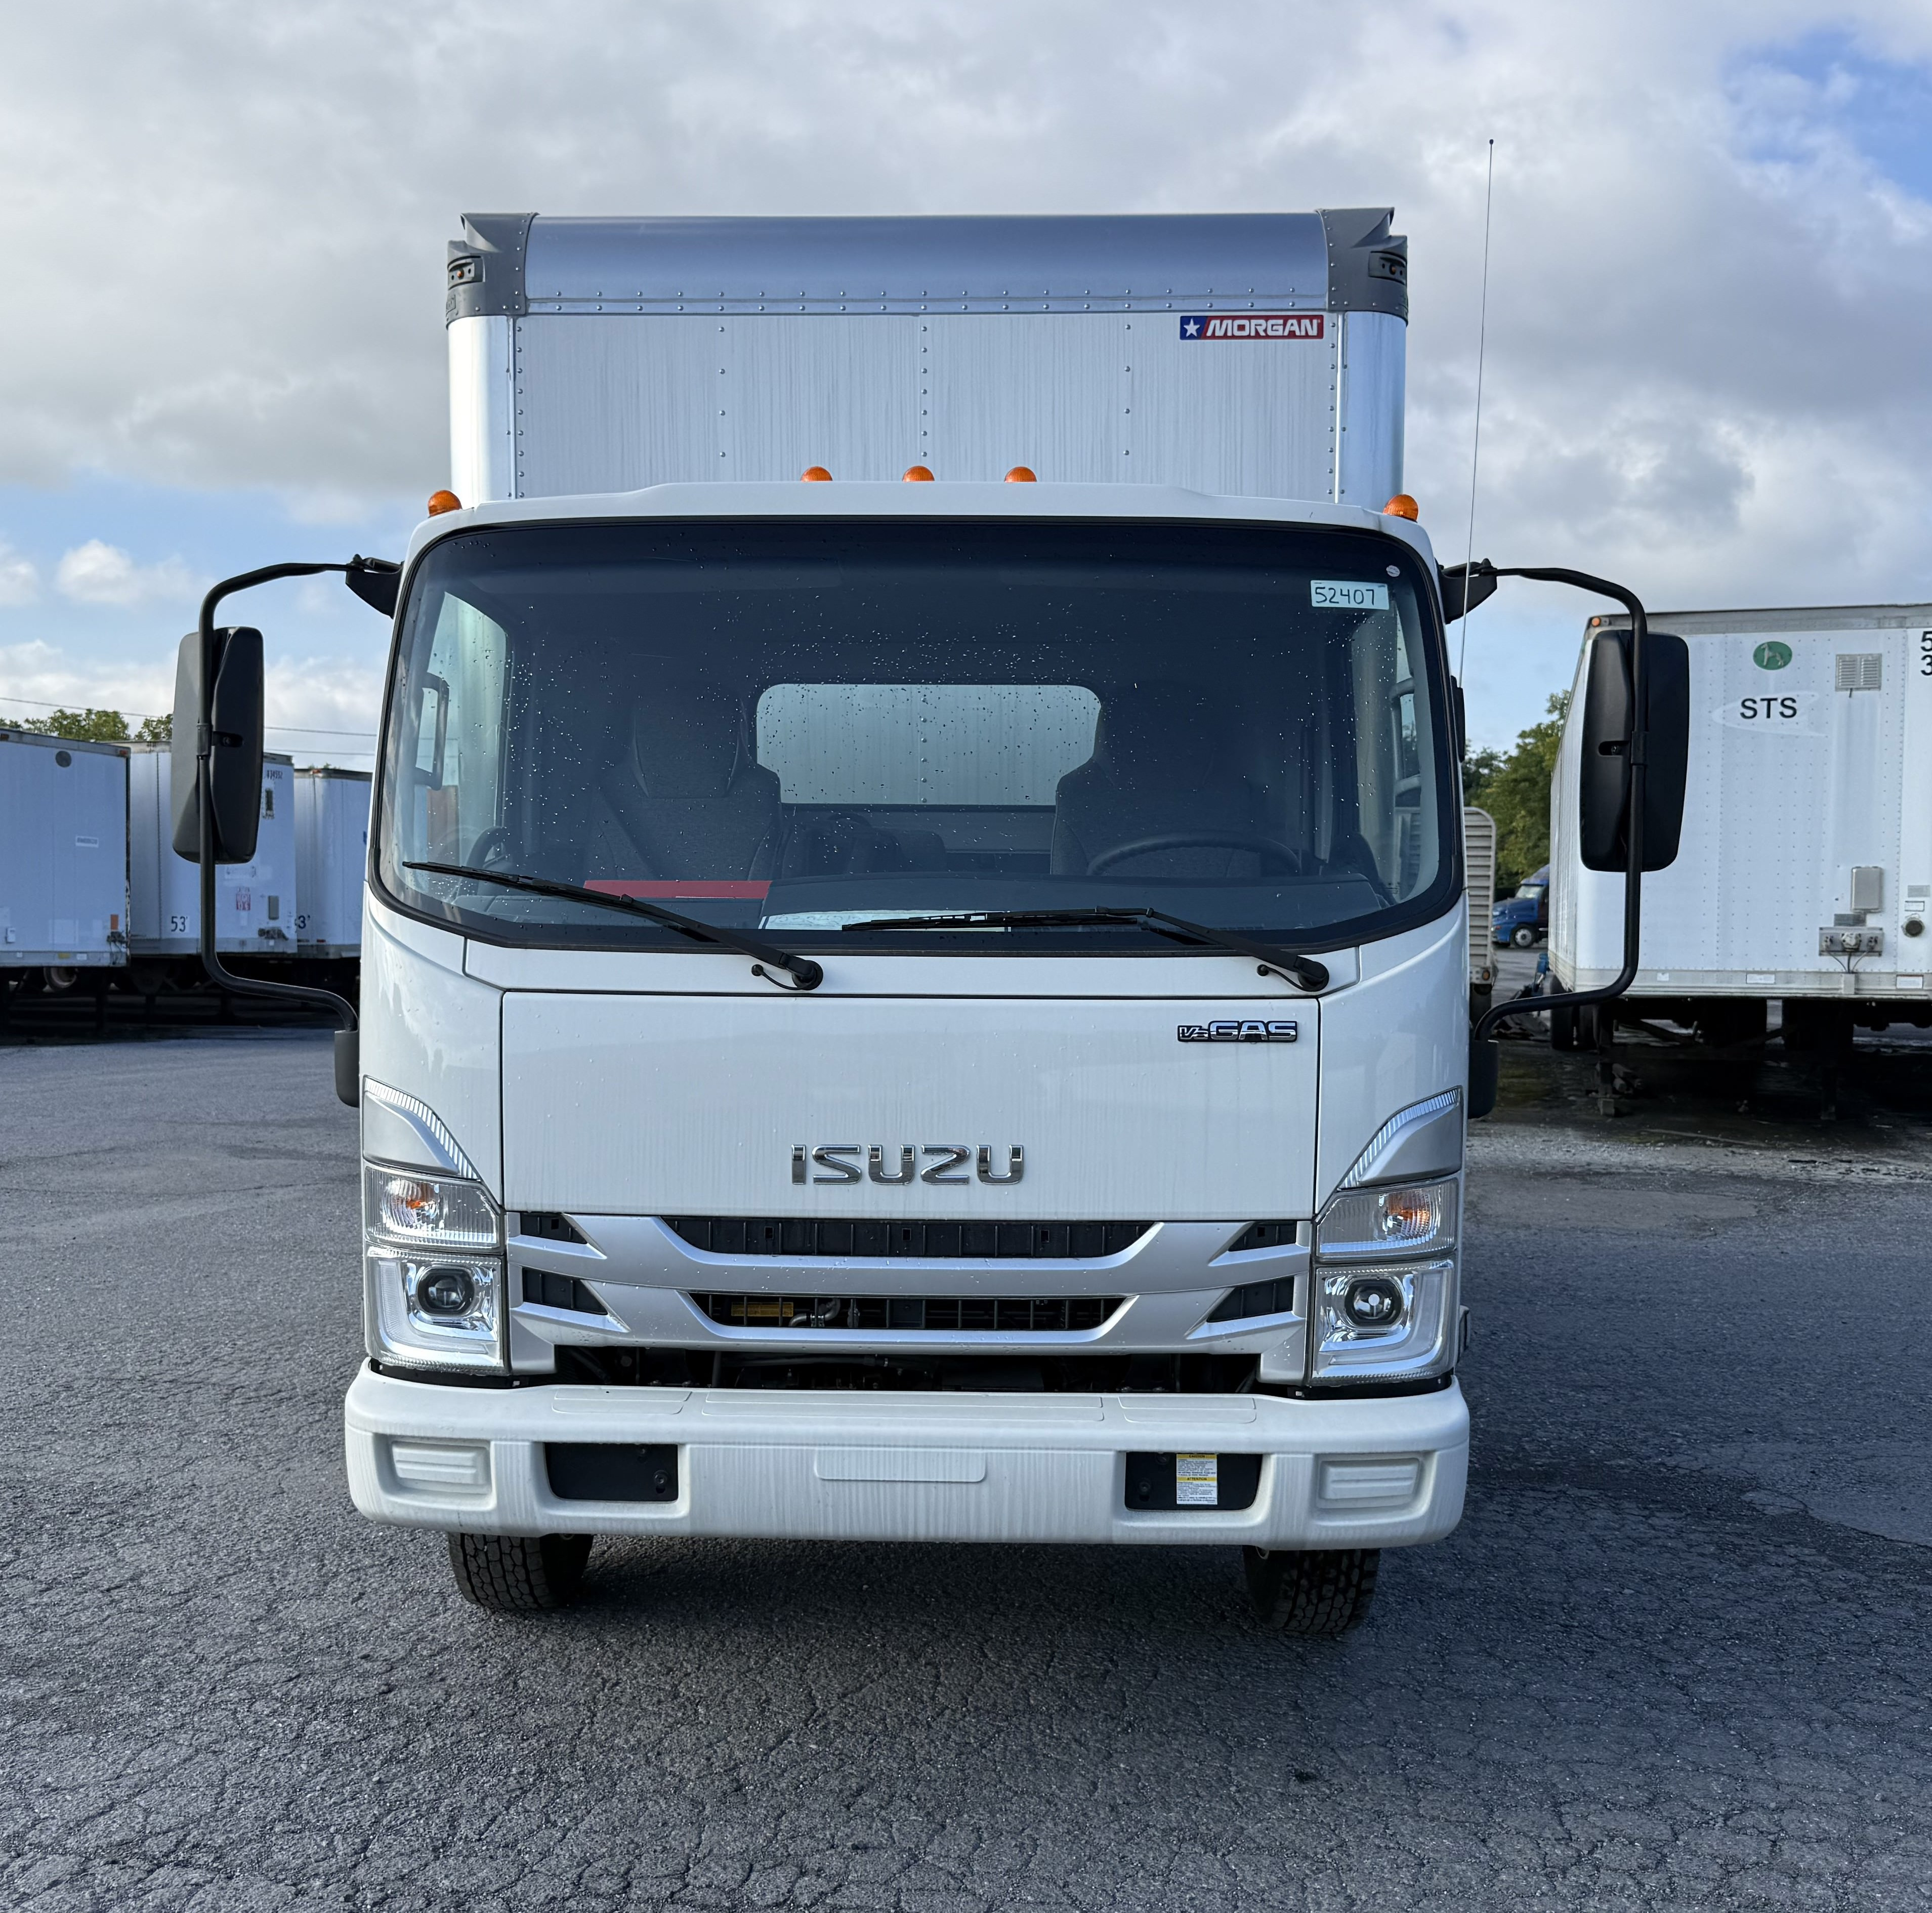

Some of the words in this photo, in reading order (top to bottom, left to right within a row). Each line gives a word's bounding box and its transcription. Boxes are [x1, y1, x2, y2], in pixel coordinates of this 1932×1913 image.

[1206, 319, 1318, 337] MORGAN
[1315, 586, 1375, 606] 52407
[1740, 697, 1797, 720] STS
[791, 1144, 1024, 1185] ISUZU
